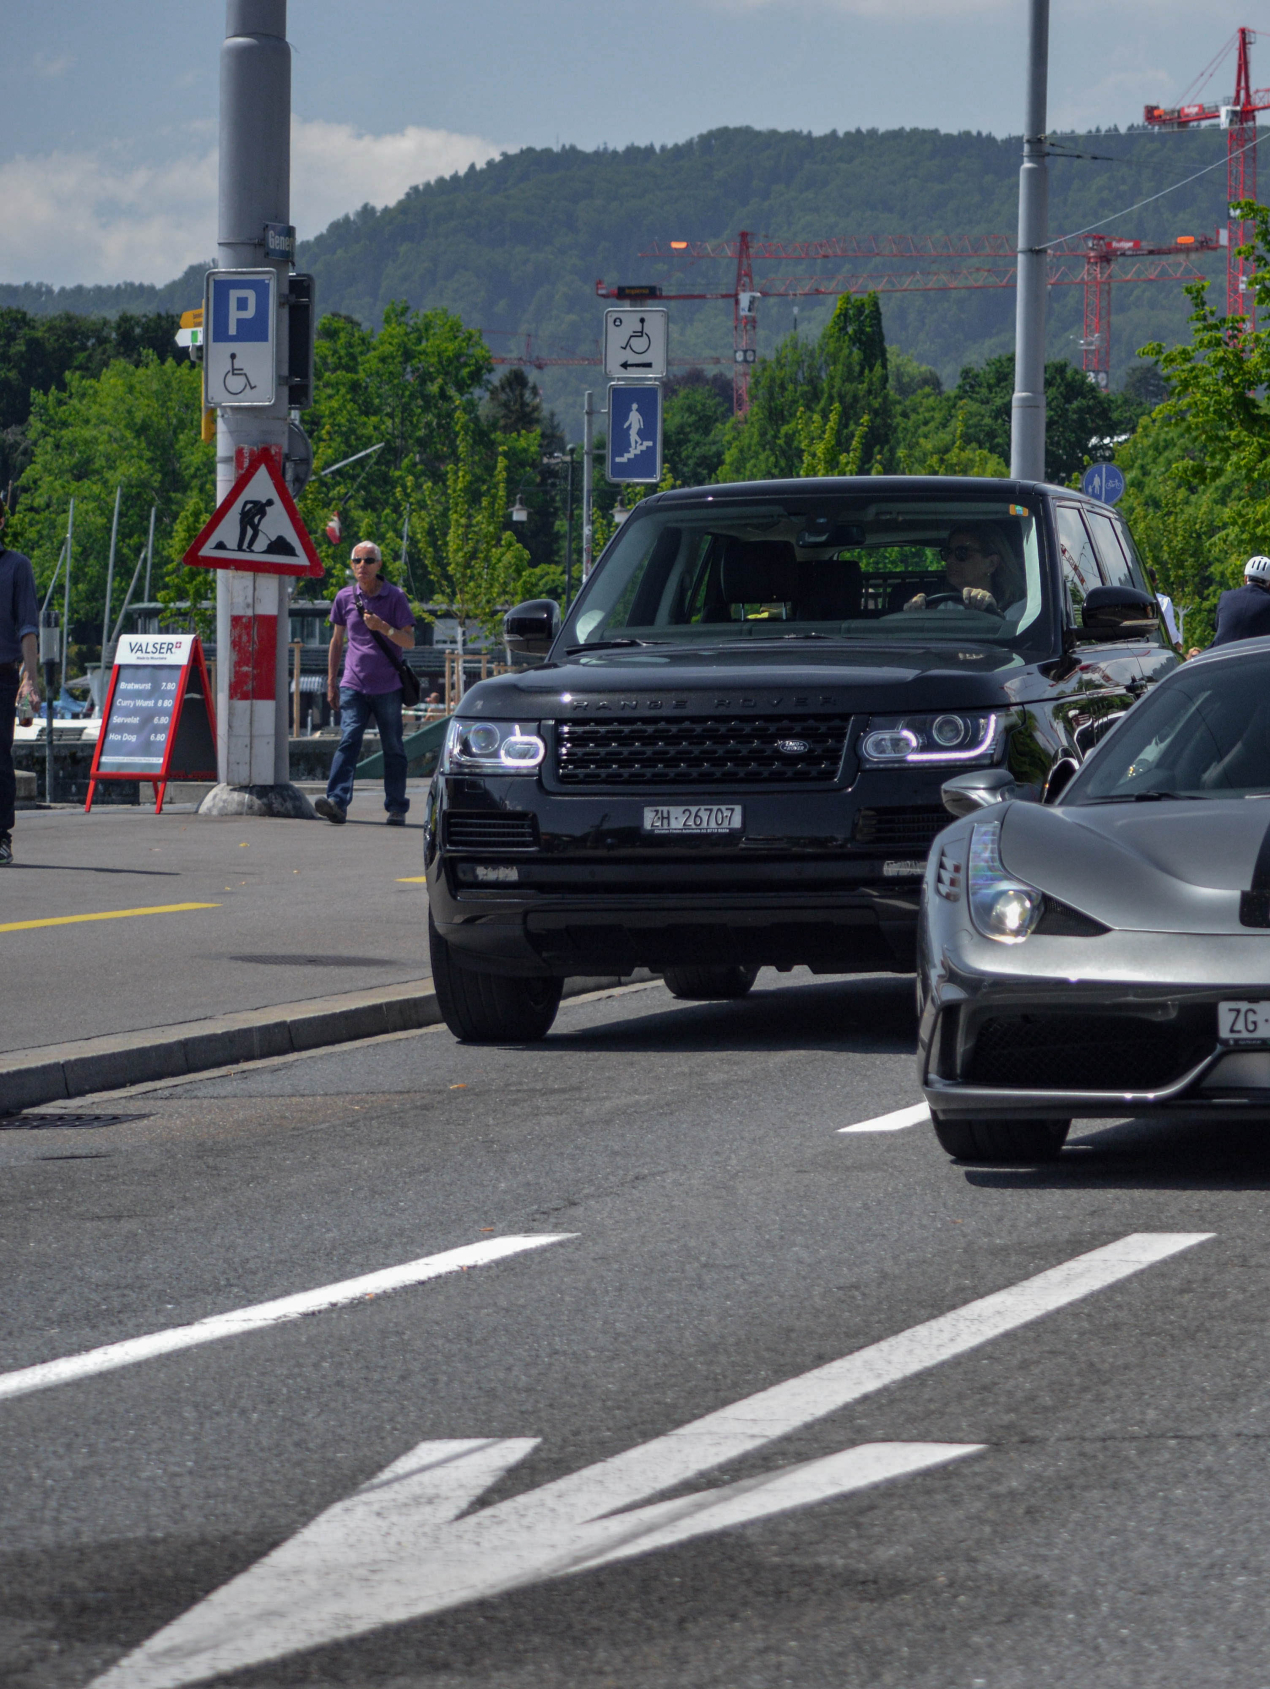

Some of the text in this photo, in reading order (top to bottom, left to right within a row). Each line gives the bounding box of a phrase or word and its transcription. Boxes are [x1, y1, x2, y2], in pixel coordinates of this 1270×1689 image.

[228, 289, 256, 335] P
[129, 642, 174, 655] VALSER
[120, 682, 176, 690] Bratwurst 7.80
[116, 699, 134, 708] Curry
[573, 696, 837, 711] RANGE ROVER
[113, 716, 139, 724] Servelat
[122, 733, 137, 742] Dog
[150, 733, 165, 741] 6.80
